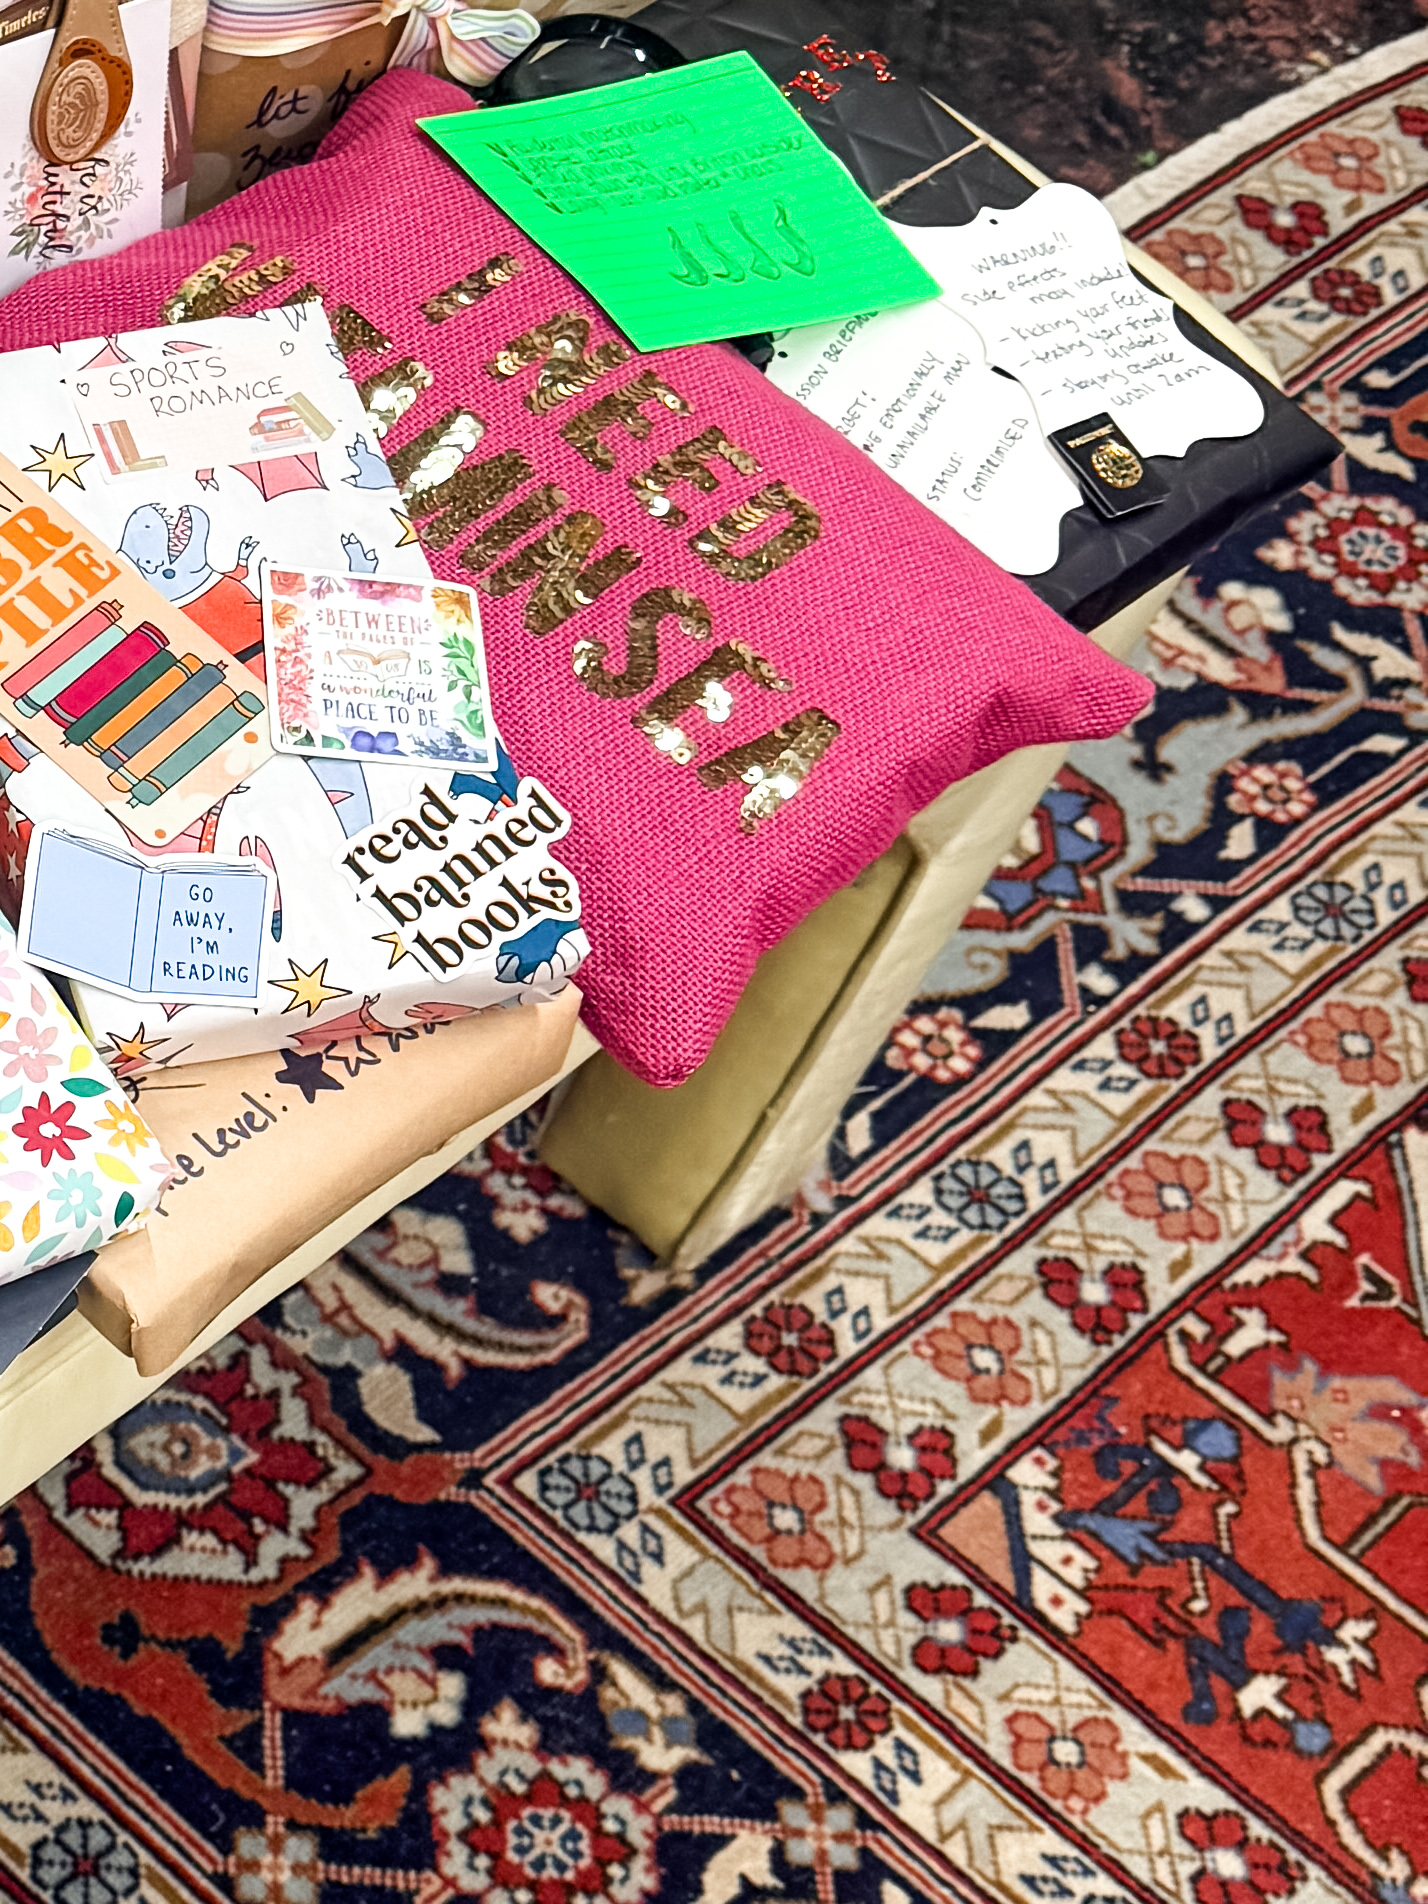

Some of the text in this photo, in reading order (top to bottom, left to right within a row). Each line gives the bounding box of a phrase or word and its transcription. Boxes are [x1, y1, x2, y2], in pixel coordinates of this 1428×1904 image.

[245, 85, 309, 129] lit
[419, 250, 526, 325] I
[109, 356, 228, 399] SPORTS
[149, 375, 284, 418] ROMANCE
[483, 309, 824, 584] NEED
[885, 390, 947, 471] UNAVAILABLE
[326, 607, 423, 635] BETWEEN
[323, 698, 439, 727] PLACE TO BE
[340, 684, 438, 705] wonderful
[340, 783, 458, 885] read
[371, 786, 564, 929] banned
[189, 883, 214, 905] GO
[171, 909, 235, 936] AWAY,
[411, 862, 577, 978] books
[189, 934, 220, 956] I'M
[161, 958, 250, 986] READING
